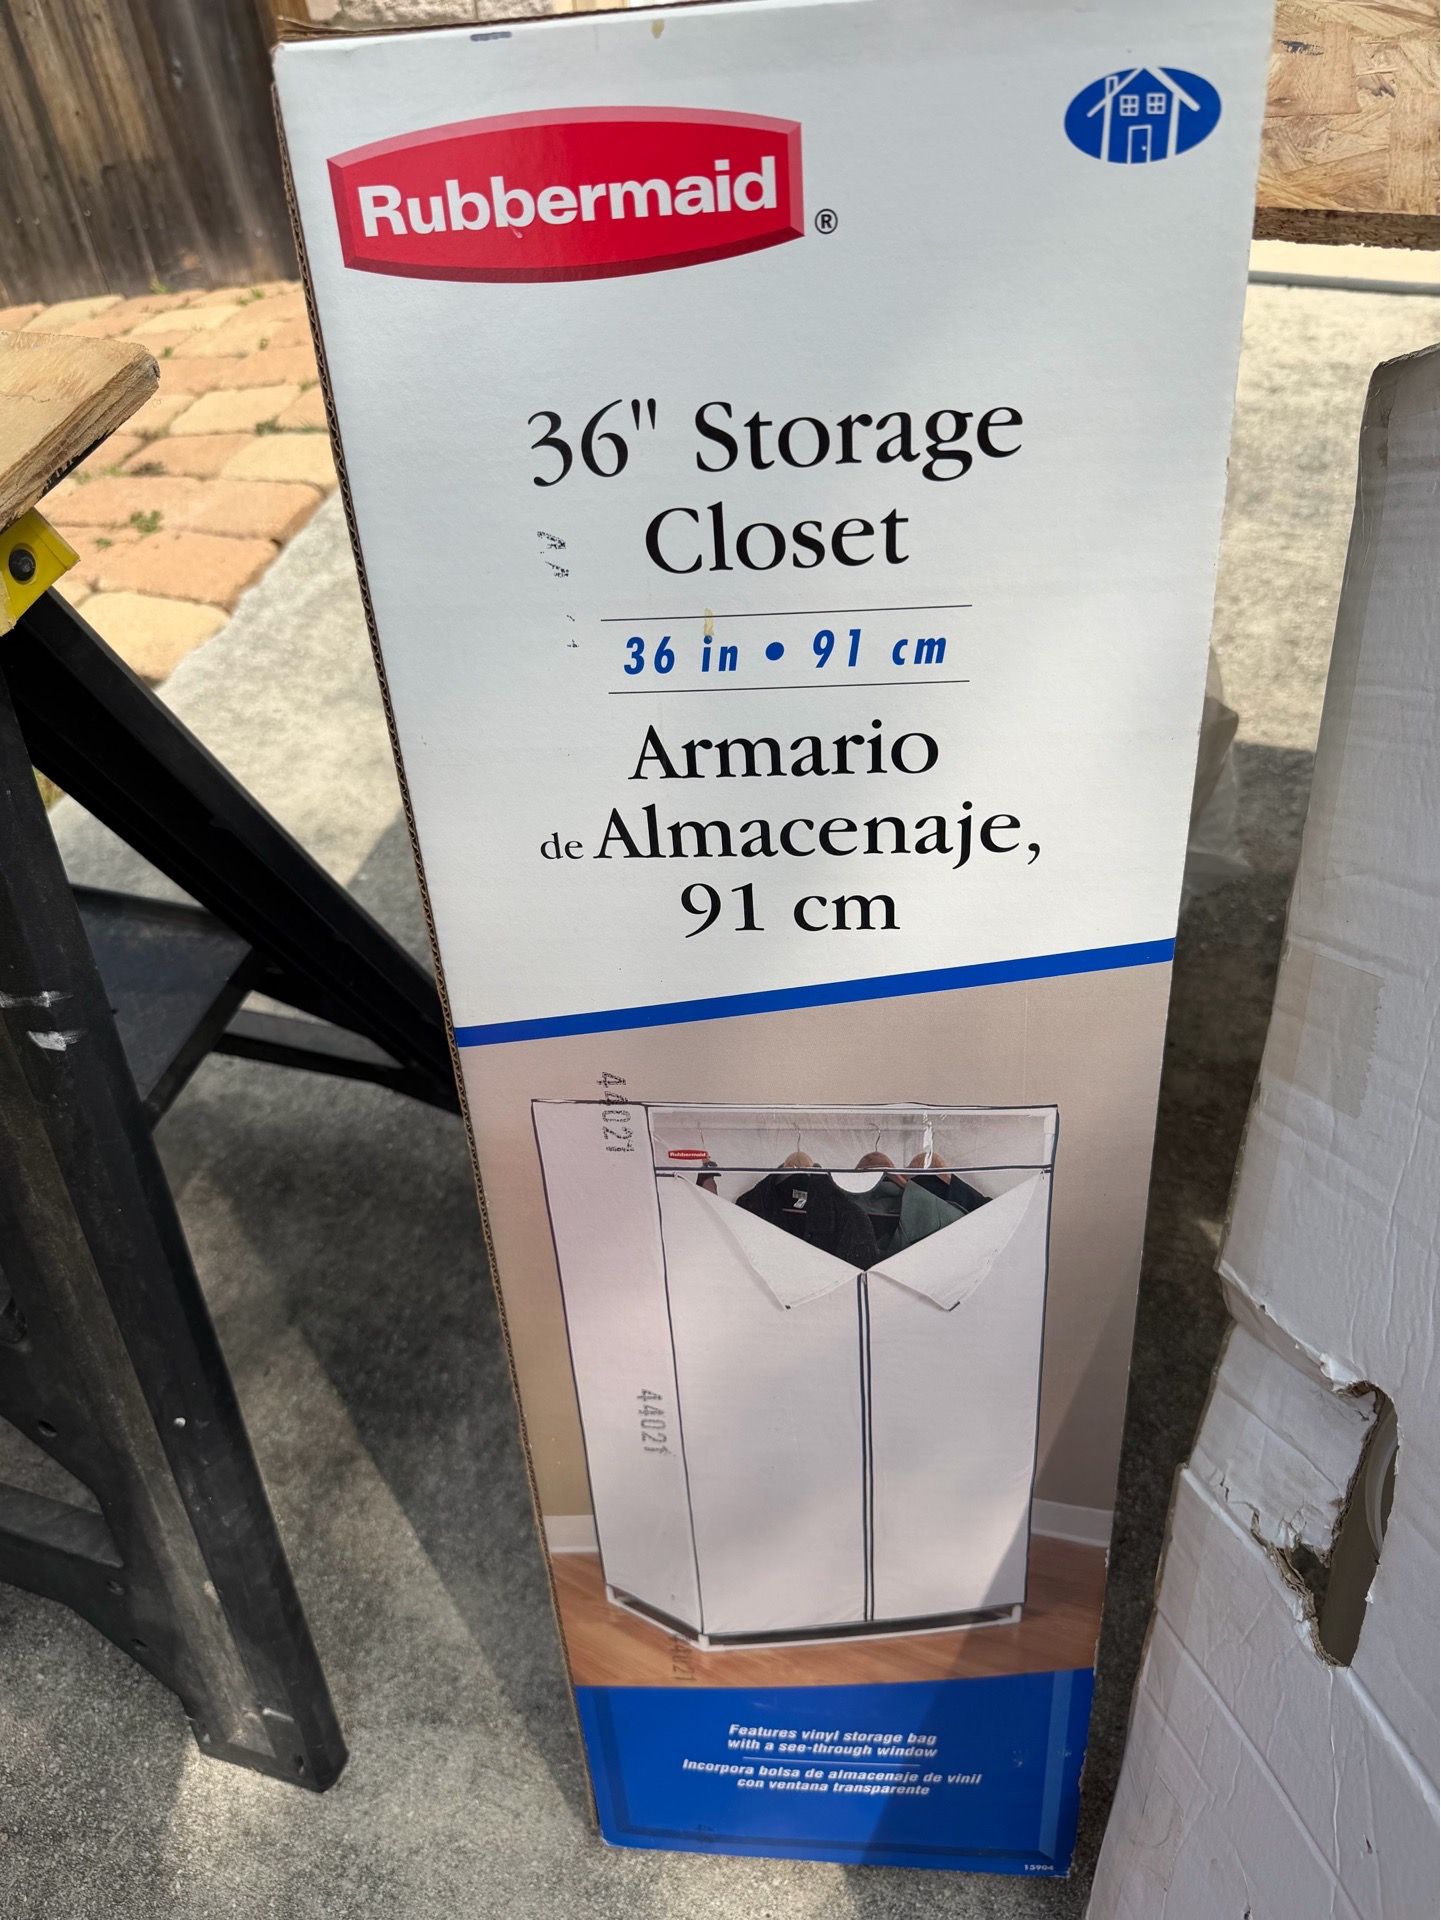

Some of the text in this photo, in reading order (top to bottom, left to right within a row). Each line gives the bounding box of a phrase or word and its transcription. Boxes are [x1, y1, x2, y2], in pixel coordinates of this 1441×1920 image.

[358, 157, 777, 238] Rubbermaid
[527, 398, 1023, 488] 36" Storage
[645, 501, 910, 575] Closet
[623, 628, 947, 675] 36 in 91 cm
[627, 718, 939, 780] Armario
[540, 800, 1041, 870] de Almacenaje,
[680, 882, 901, 939] 91 cm
[727, 1738, 938, 1757] with a see-through window
[729, 1723, 938, 1745] Features vinyl storage bag
[682, 1758, 982, 1784] Incorpora bolsa de almacenaje de vinil
[736, 1777, 930, 1795] con ventana transparente
